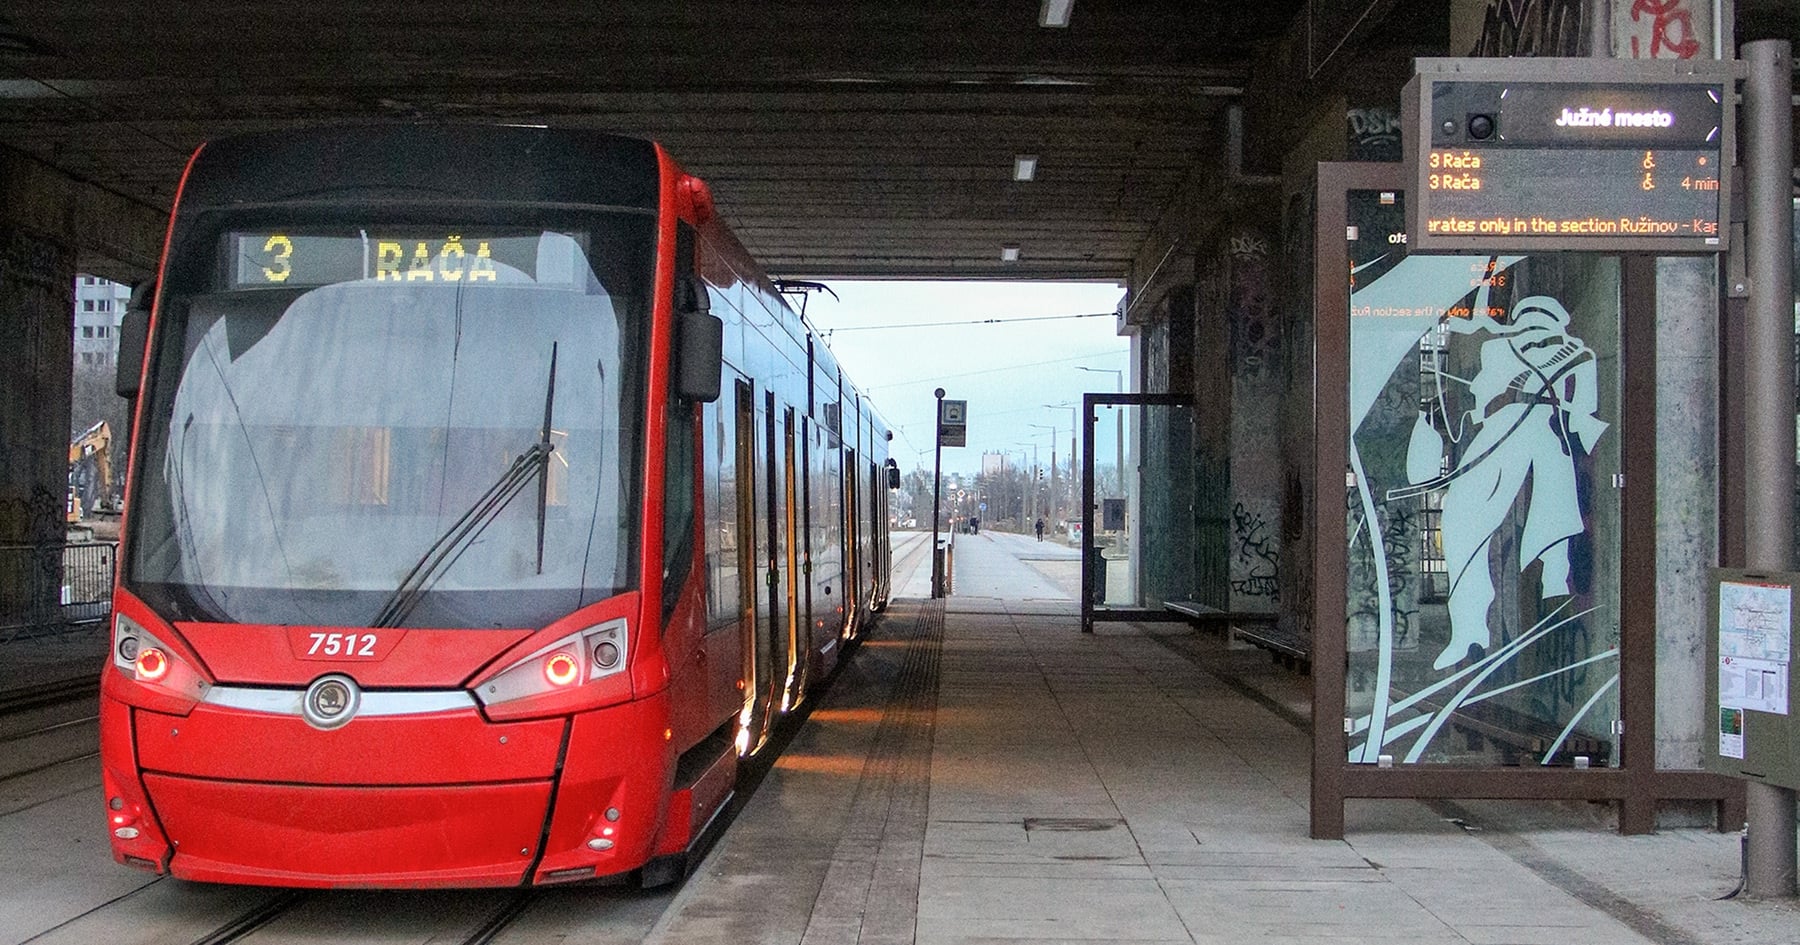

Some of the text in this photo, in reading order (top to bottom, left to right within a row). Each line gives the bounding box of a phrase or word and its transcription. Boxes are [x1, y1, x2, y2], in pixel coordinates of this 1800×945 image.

[1555, 107, 1673, 127] Južné mesto
[1429, 151, 1481, 168] 3 Rača
[1429, 172, 1481, 190] 3 Rača
[1681, 176, 1719, 190] 4 min
[1479, 217, 1511, 234] only
[1514, 217, 1527, 233] in
[1530, 217, 1557, 233] the
[1560, 217, 1617, 233] section
[1620, 216, 1678, 233] Ružinov
[263, 234, 497, 282] 3 RAČA
[307, 632, 378, 656] 7512
